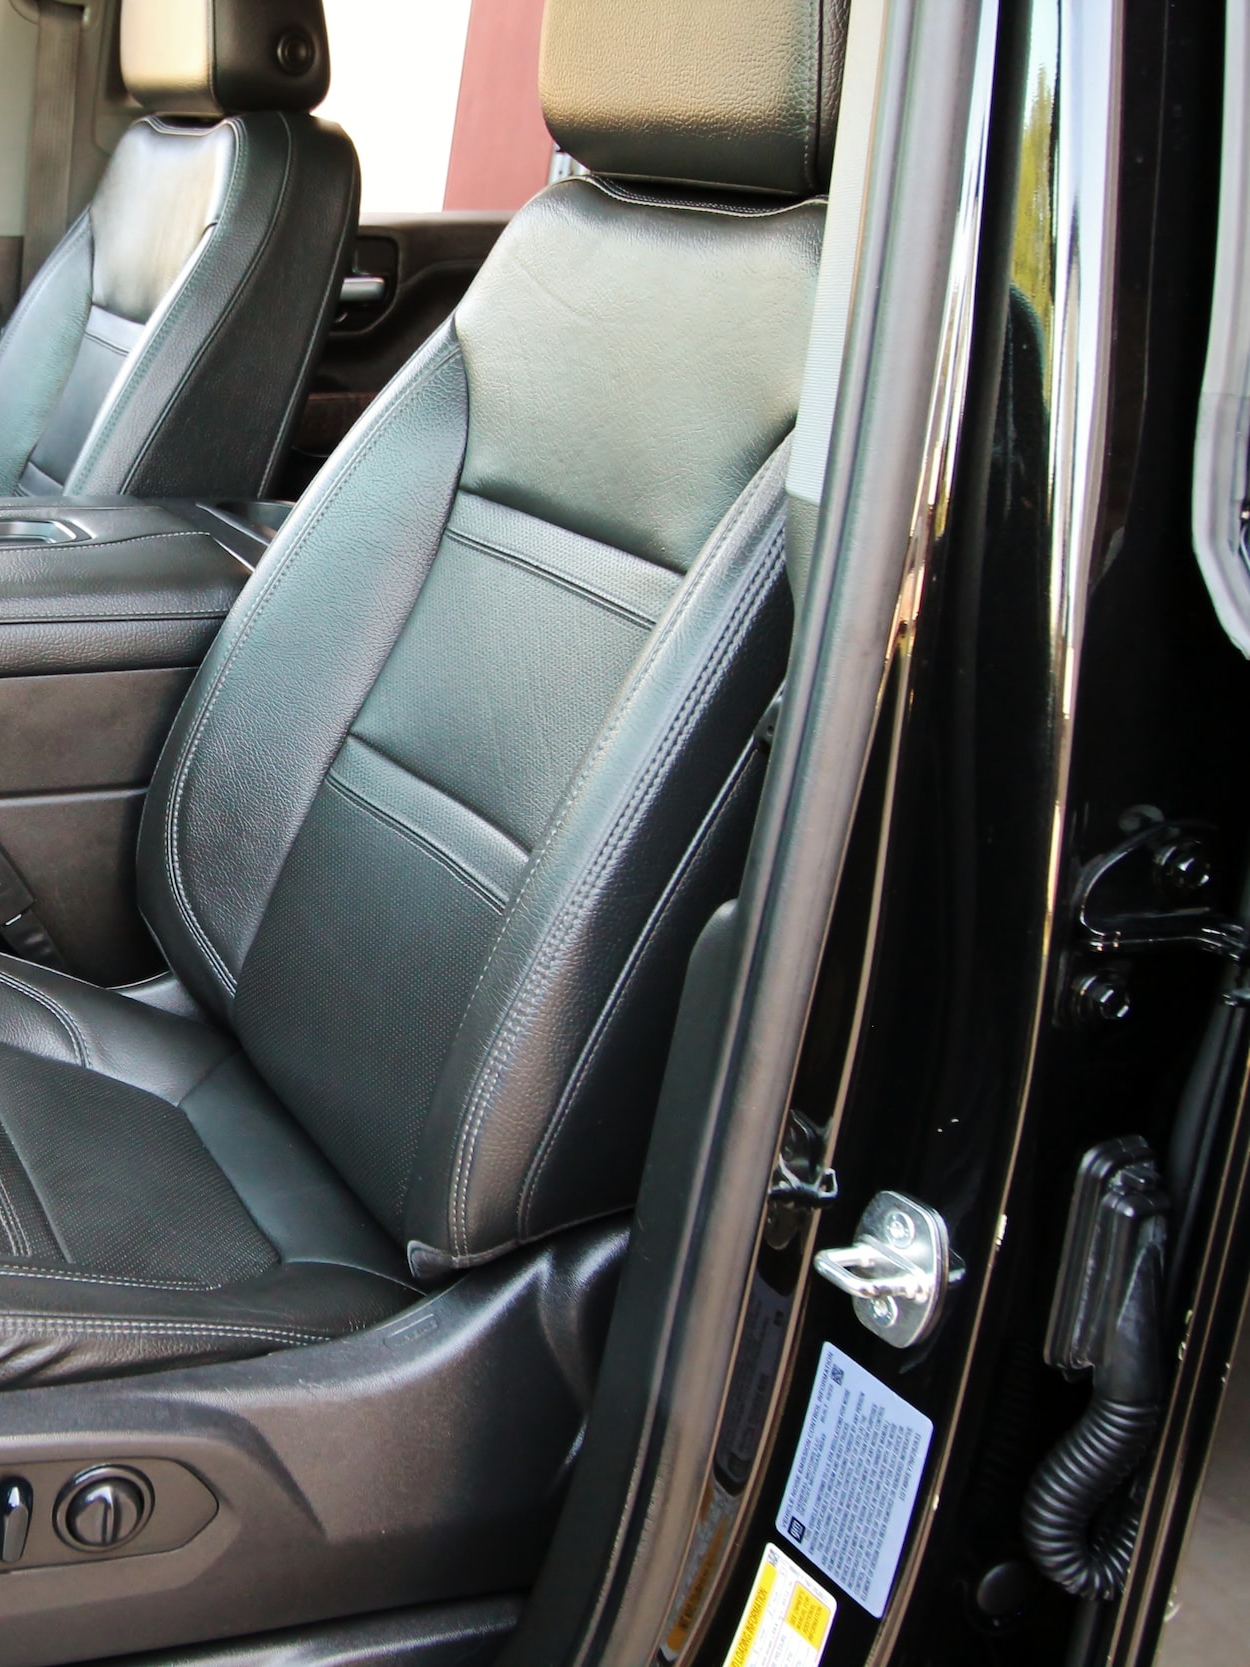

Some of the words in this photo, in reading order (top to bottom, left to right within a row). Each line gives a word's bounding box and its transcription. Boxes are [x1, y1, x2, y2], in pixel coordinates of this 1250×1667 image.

[782, 1496, 794, 1530] VEHICLE
[790, 1472, 800, 1498] NOISE
[796, 1436, 810, 1474] EMISSION
[806, 1401, 820, 1438] CONTROL
[815, 1351, 833, 1402] INFORMATION
[733, 1629, 752, 1666] LOADING
[744, 1585, 767, 1635] INFORMATION
